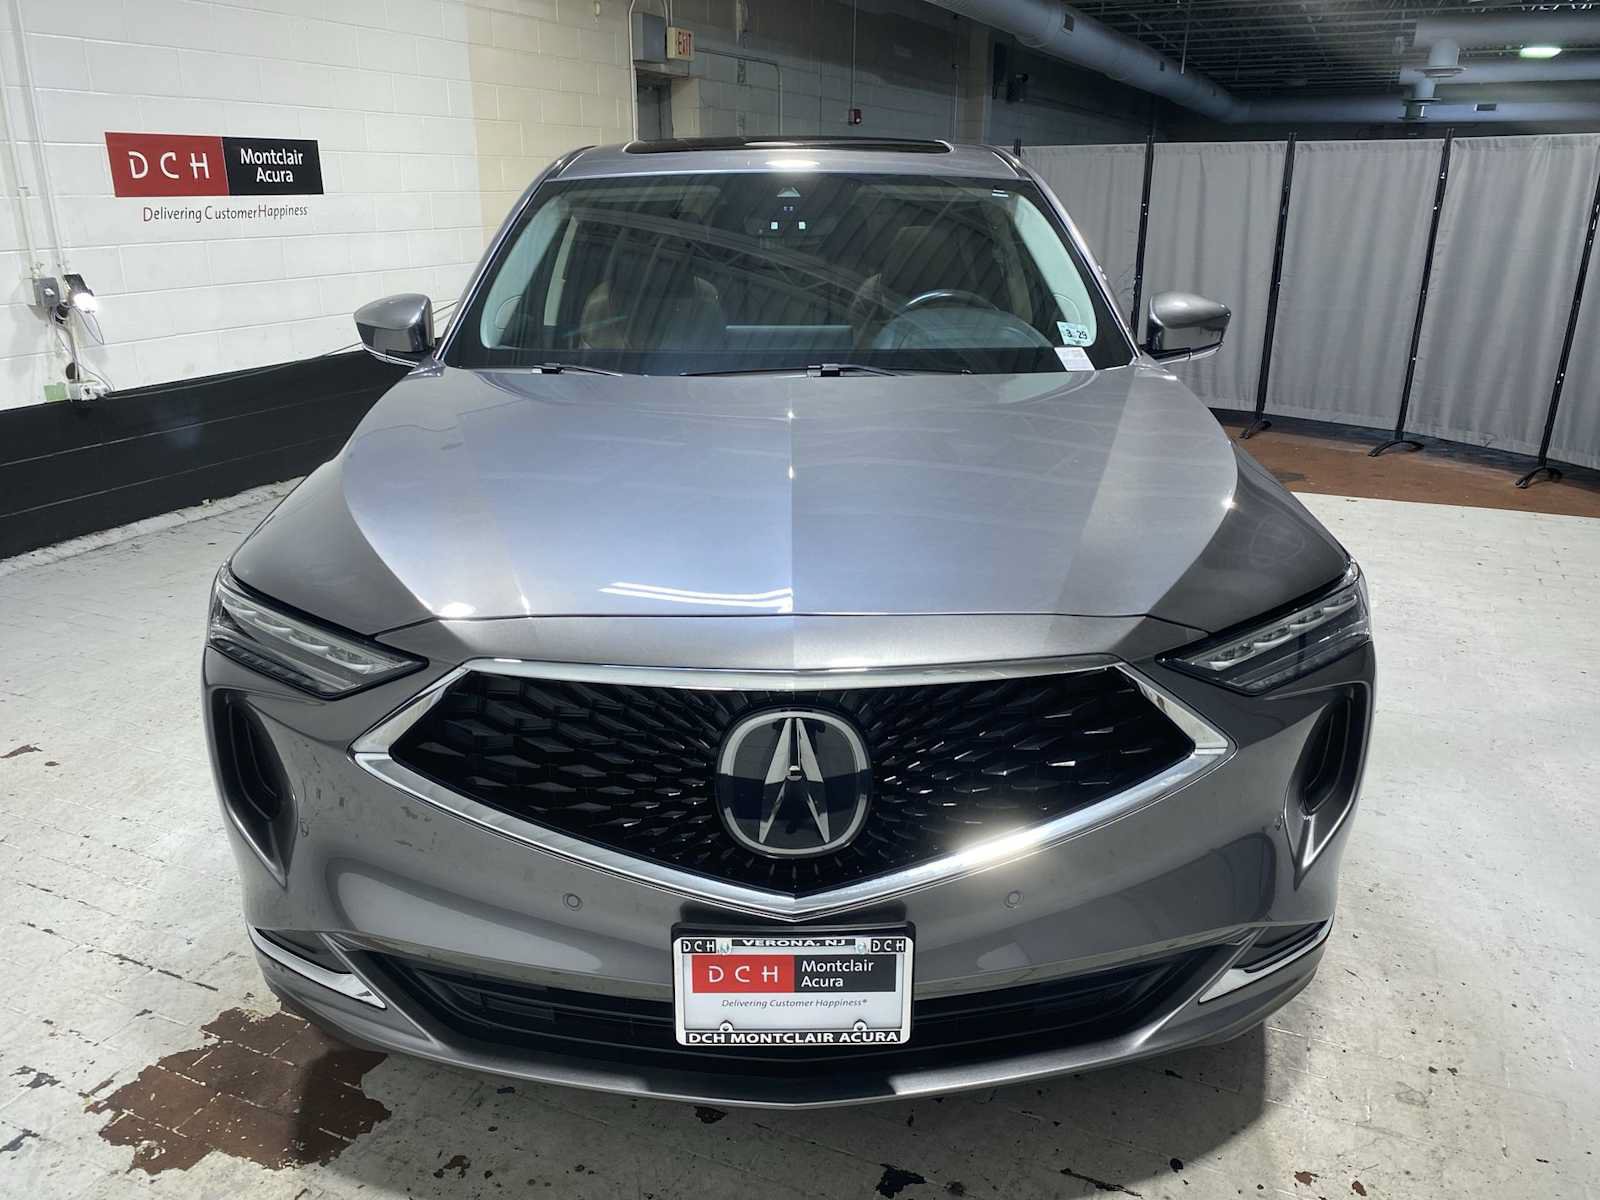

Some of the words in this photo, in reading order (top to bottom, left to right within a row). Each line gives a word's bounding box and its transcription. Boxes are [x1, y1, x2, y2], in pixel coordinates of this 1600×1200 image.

[240, 148, 304, 166] Montclair
[256, 167, 294, 183] Acura
[143, 207, 202, 223] Delivering
[204, 205, 258, 221] Customer
[258, 203, 308, 220] Happiness
[683, 940, 715, 952] DCH
[825, 938, 846, 946] NJ
[872, 940, 905, 952] DCH
[801, 959, 875, 973] Montclair
[708, 965, 779, 983] DCH
[801, 976, 844, 988] Acura
[721, 999, 768, 1009] Delivering
[769, 999, 814, 1007] Customer
[689, 1033, 725, 1044] DCH
[730, 1032, 834, 1044] MONTCLAIR
[839, 1031, 898, 1042] ACURA
